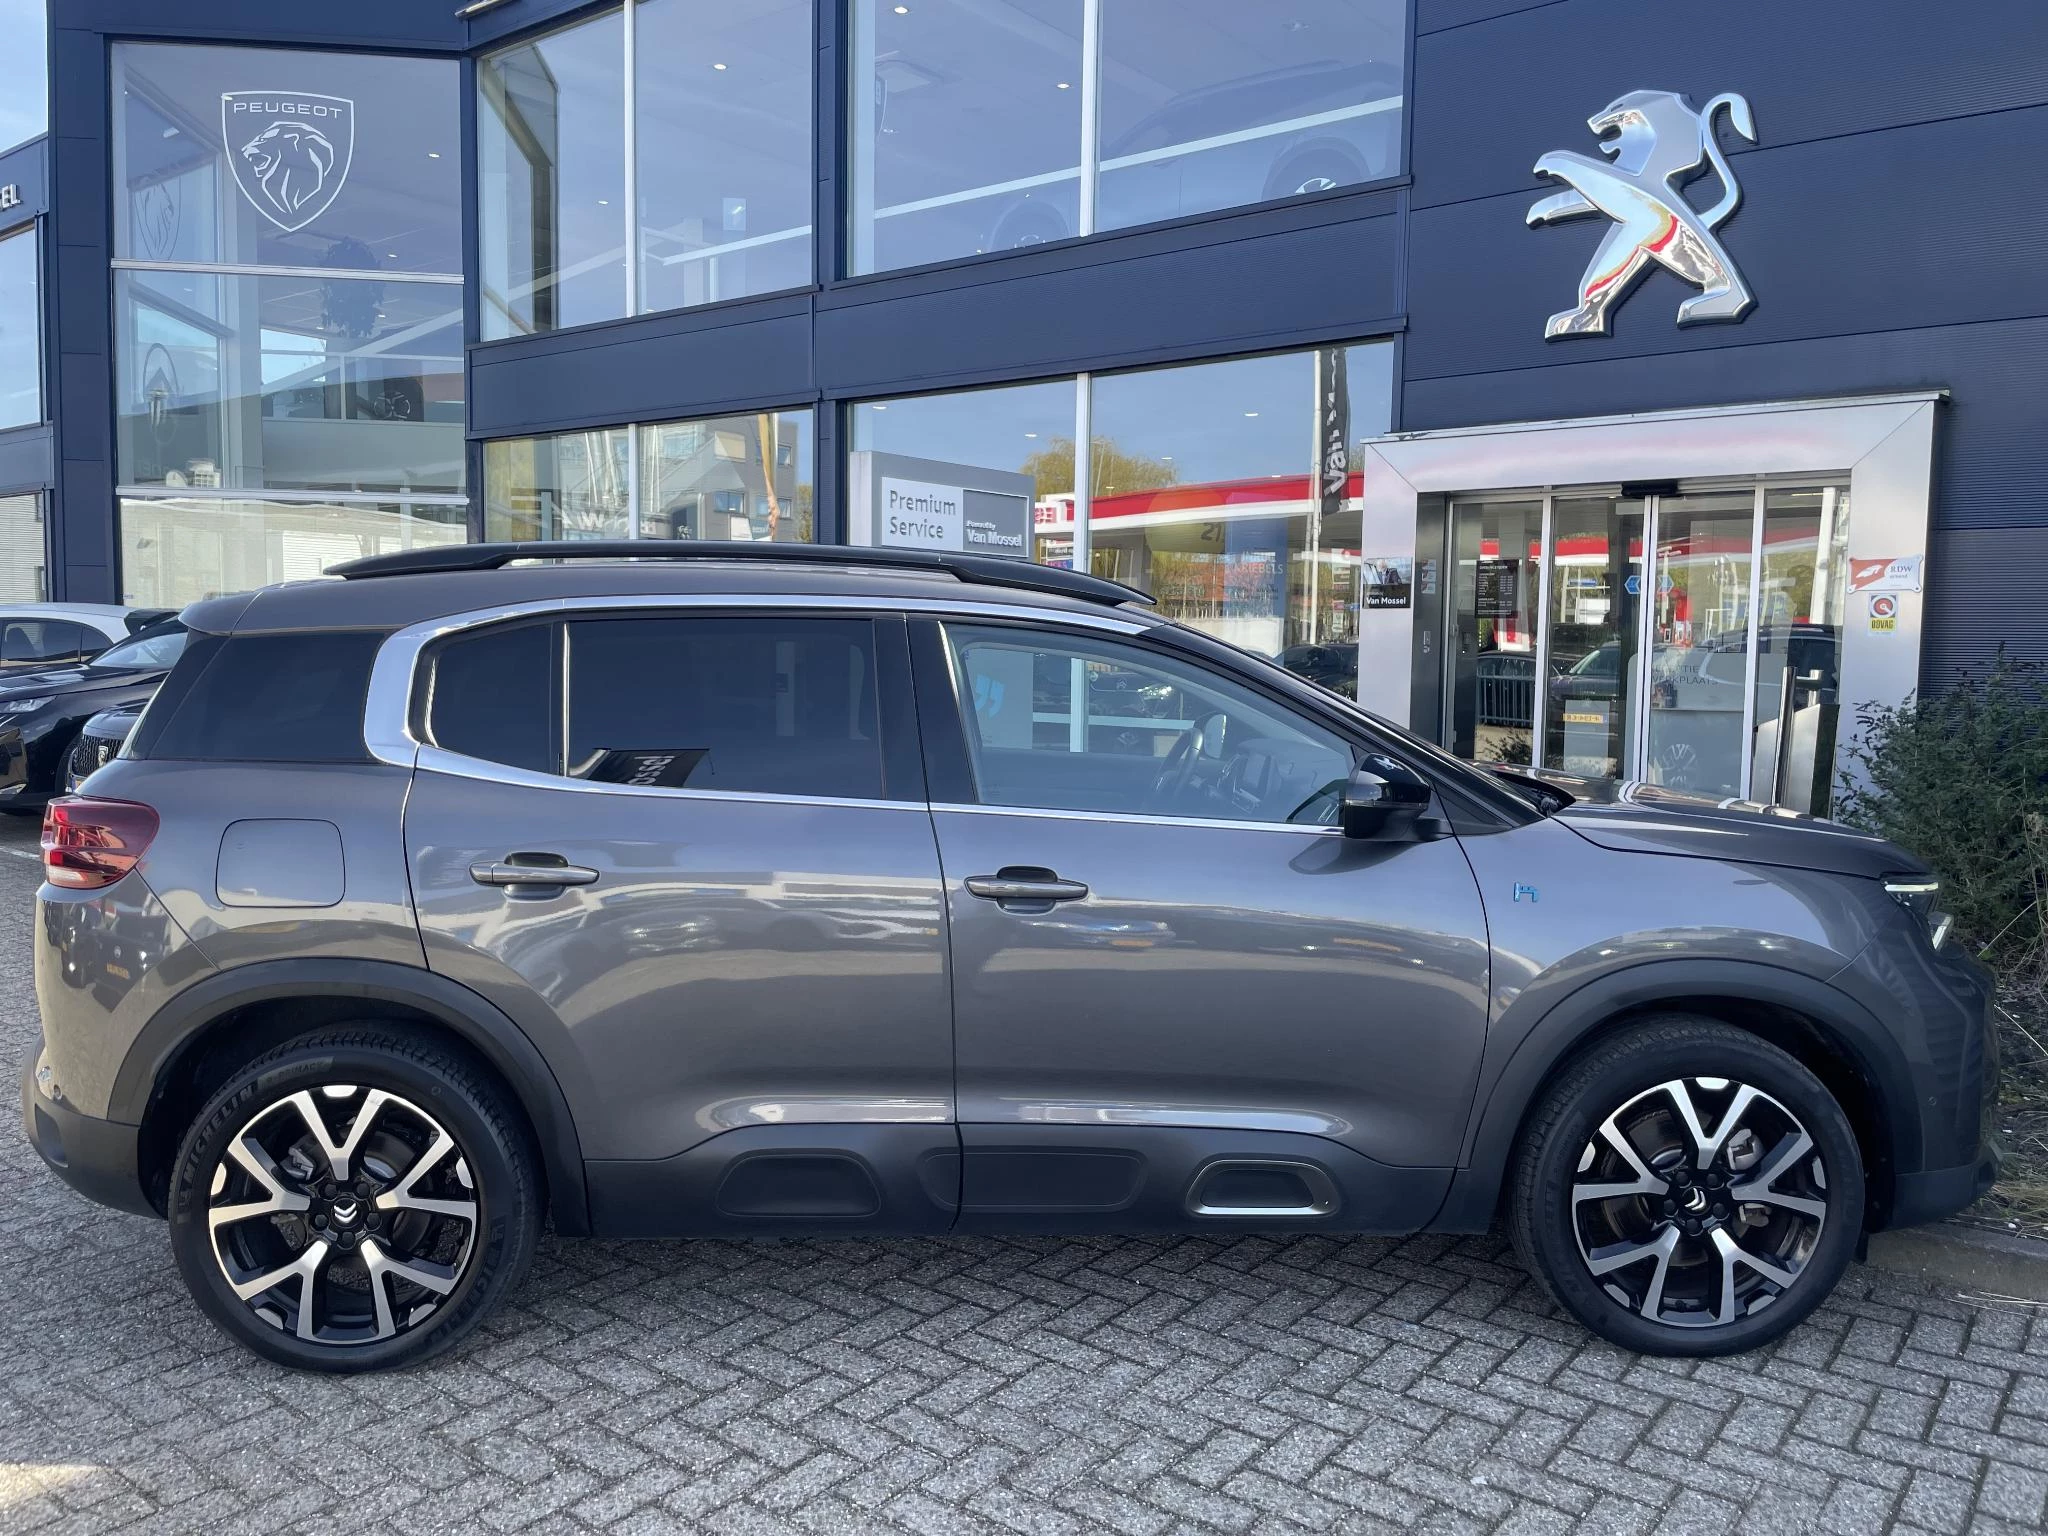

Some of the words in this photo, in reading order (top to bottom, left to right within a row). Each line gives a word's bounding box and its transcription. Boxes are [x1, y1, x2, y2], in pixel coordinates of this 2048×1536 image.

[233, 102, 343, 119] PEUGEOT
[0, 183, 21, 209] EL
[889, 489, 956, 515] Premium
[889, 516, 944, 539] Service
[966, 528, 986, 544] Van
[987, 531, 1022, 547] Mossel
[1889, 565, 1913, 573] RDW
[1366, 596, 1380, 605] Van
[1380, 596, 1406, 605] Mossel
[182, 1084, 255, 1184] MICHELIN
